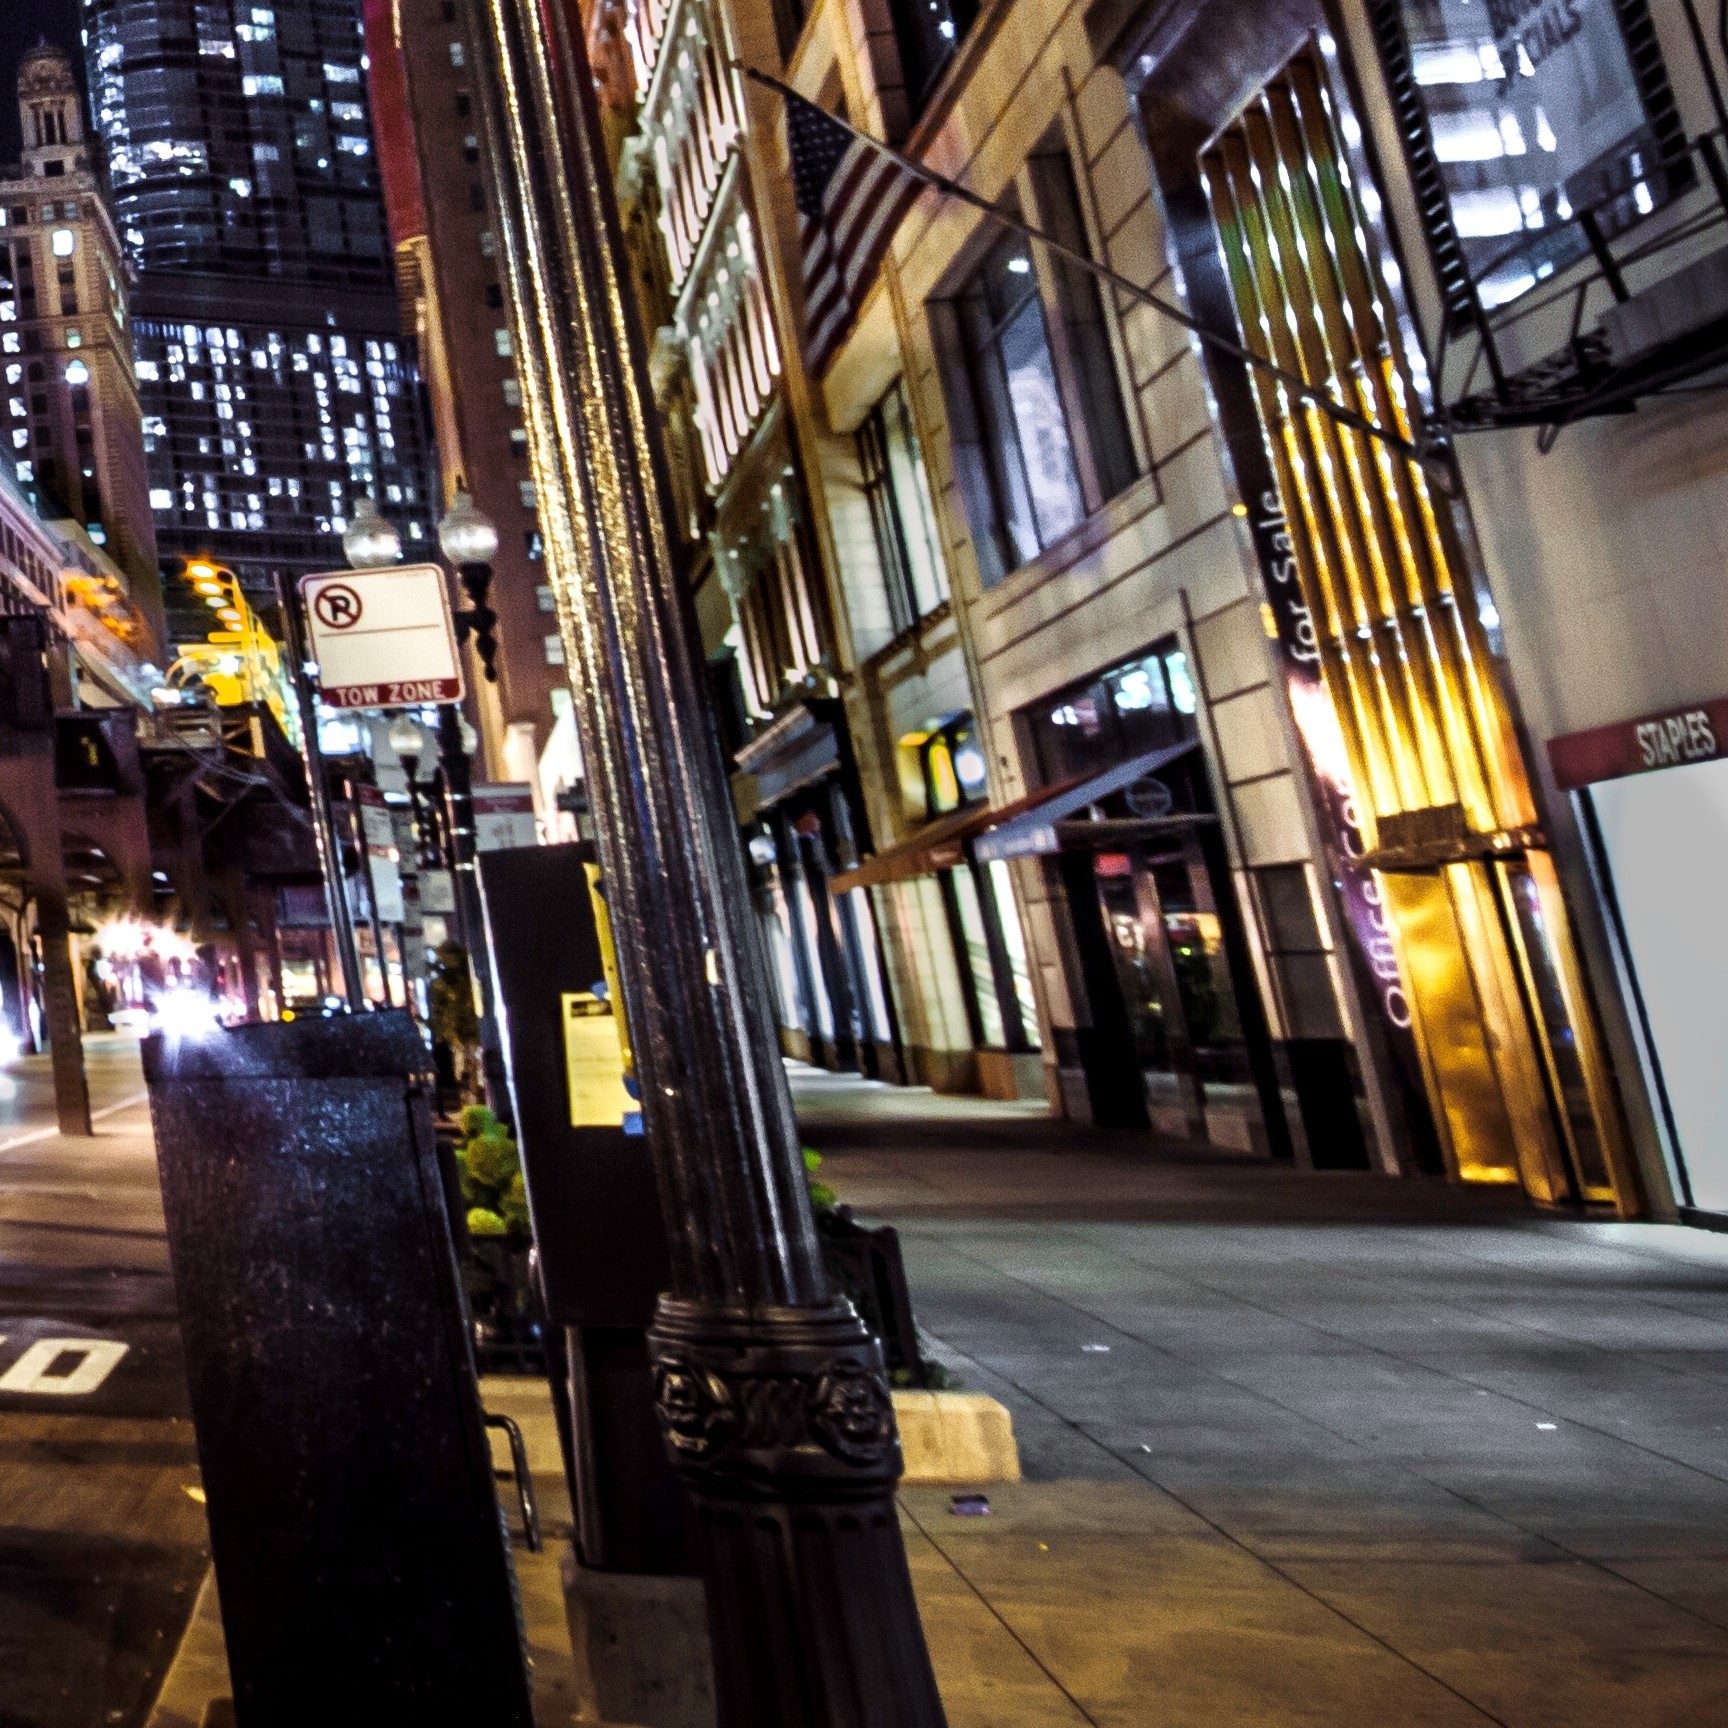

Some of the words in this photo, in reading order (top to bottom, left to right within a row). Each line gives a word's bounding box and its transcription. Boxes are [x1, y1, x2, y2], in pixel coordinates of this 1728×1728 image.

[1258, 490, 1298, 583] Sale
[1287, 600, 1321, 662] for
[335, 685, 380, 706] TOW
[388, 680, 447, 703] ZONE
[1636, 710, 1716, 766] STAPLES
[1362, 879, 1411, 1028] Office
